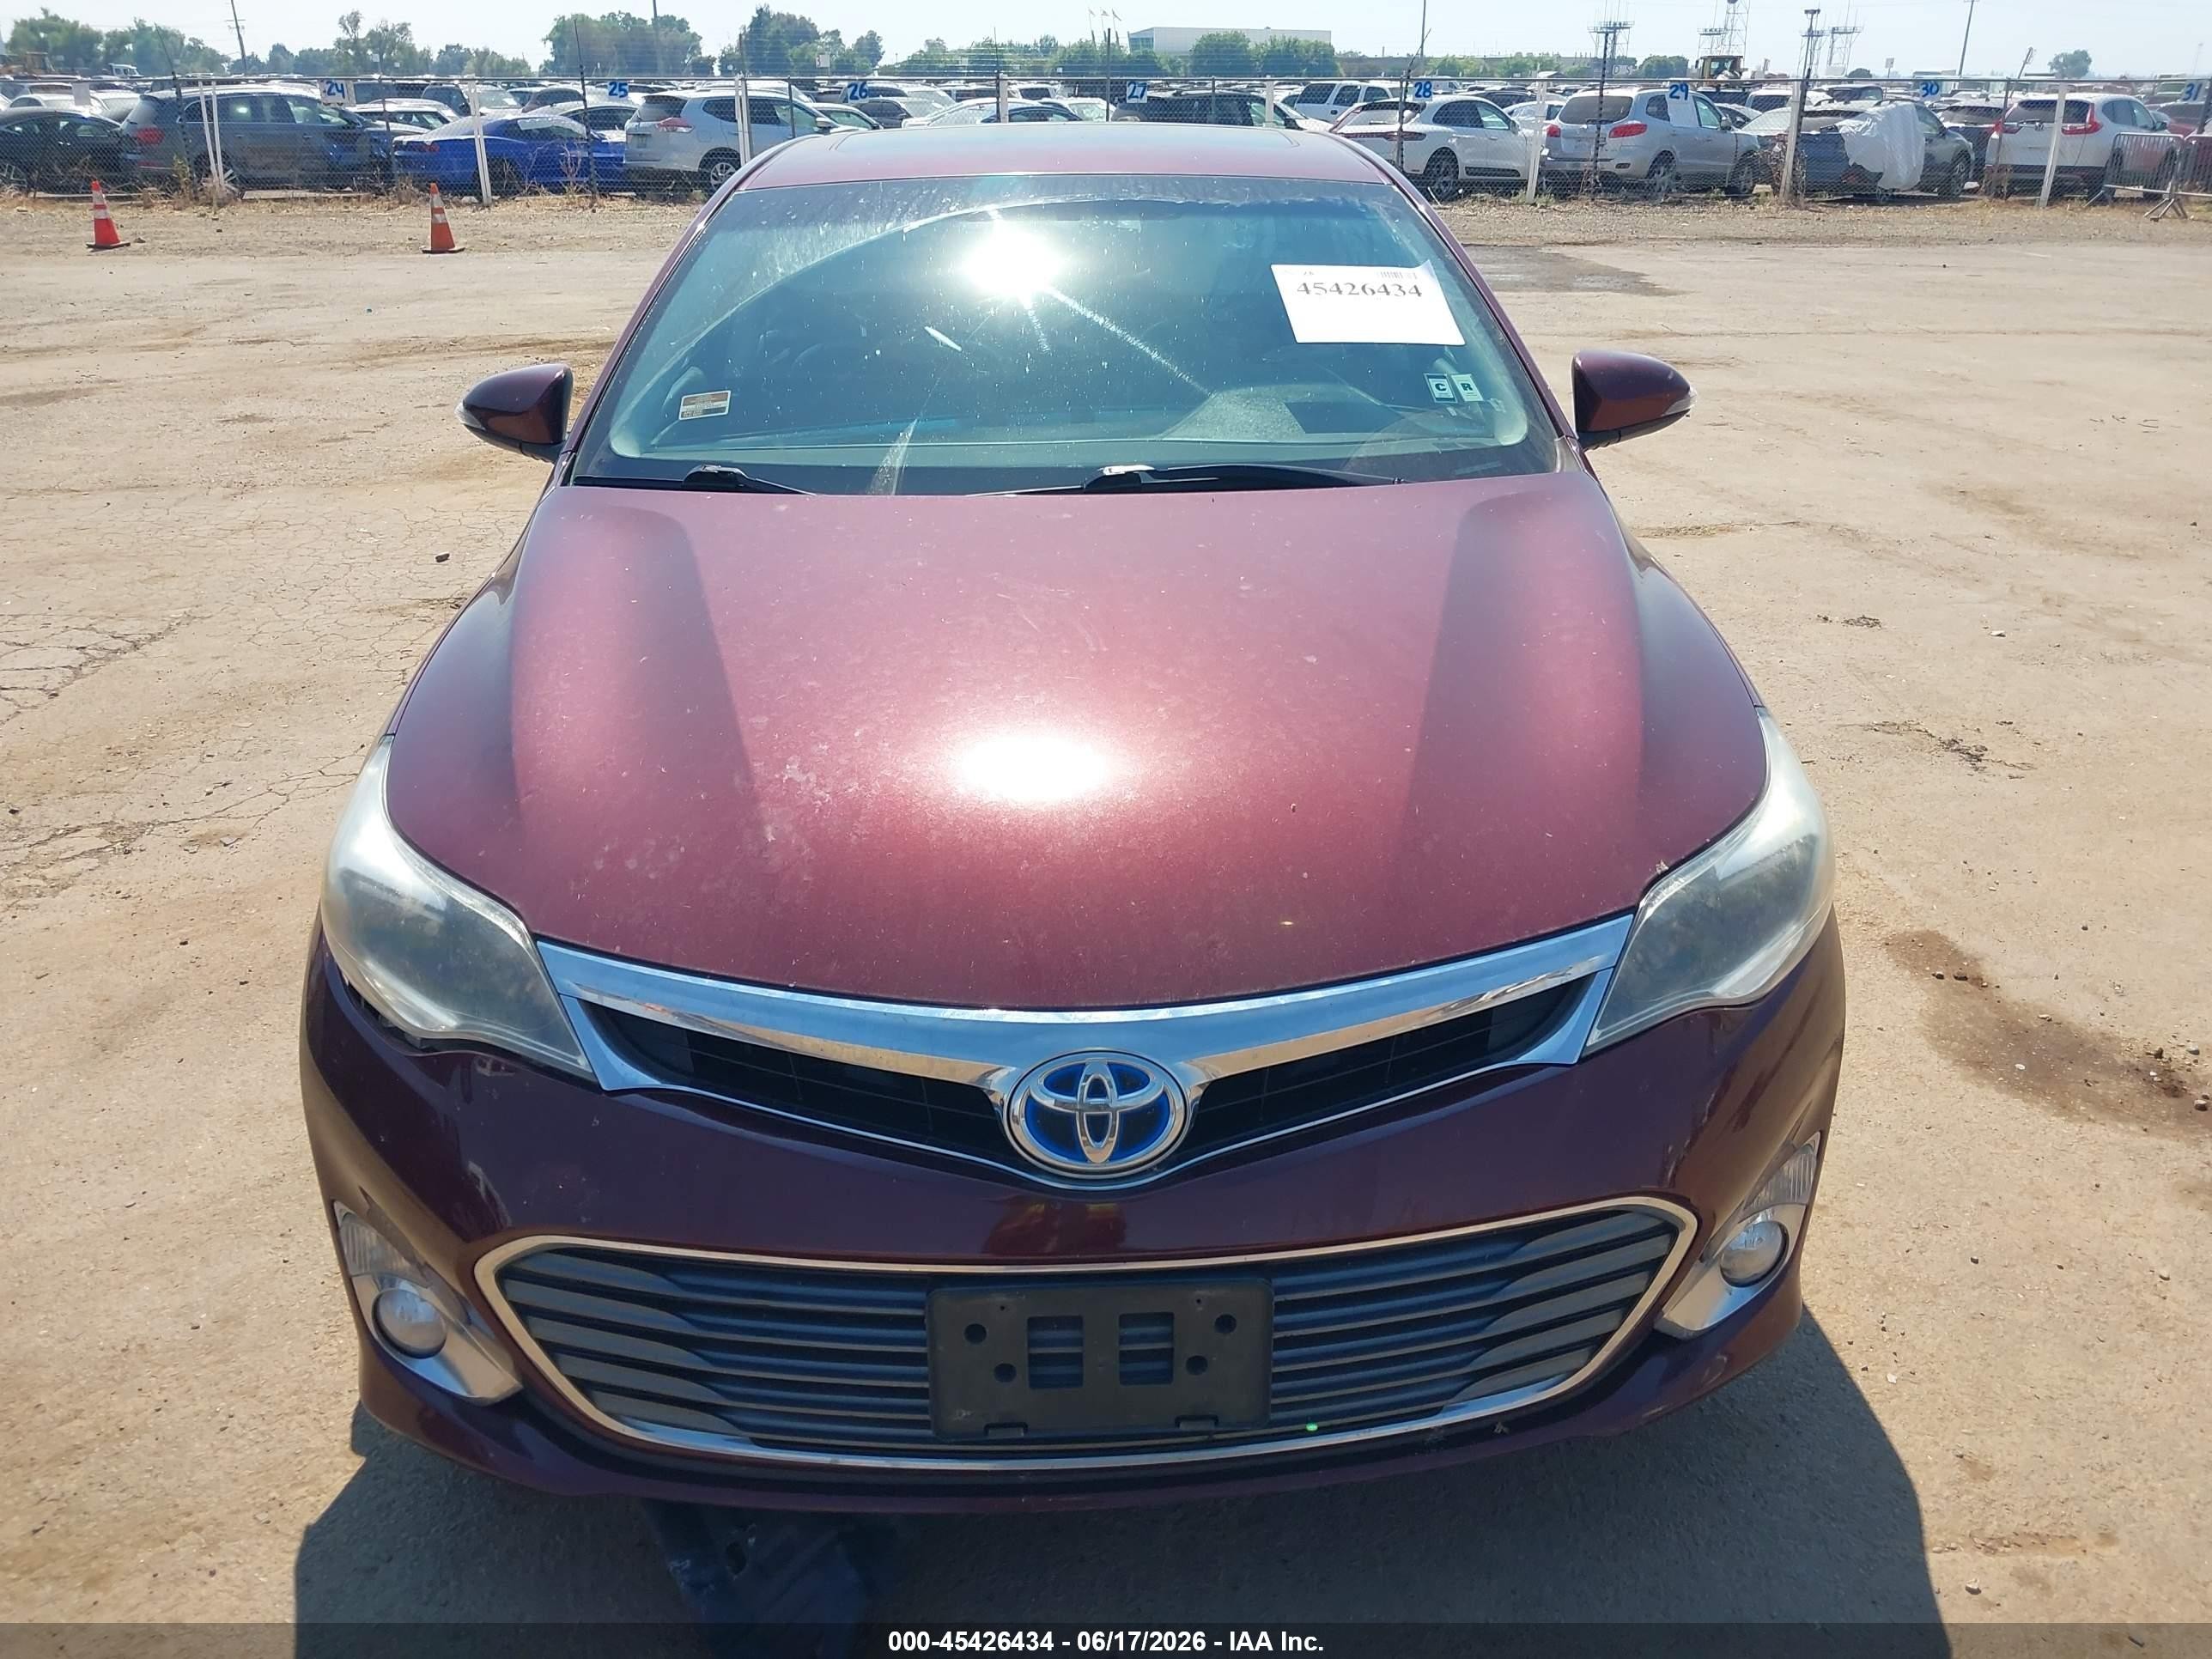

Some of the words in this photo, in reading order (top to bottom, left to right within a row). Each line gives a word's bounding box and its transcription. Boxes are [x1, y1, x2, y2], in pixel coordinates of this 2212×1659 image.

[325, 81, 345, 99] 24
[608, 81, 628, 98] 25
[848, 81, 868, 100] 26
[1127, 81, 1147, 100] 27
[1413, 81, 1432, 99] 28
[1669, 82, 1689, 100] 29
[1920, 80, 1940, 98] 30
[2182, 82, 2203, 101] 31
[1297, 283, 1422, 297] 45426434
[1435, 383, 1447, 392] C
